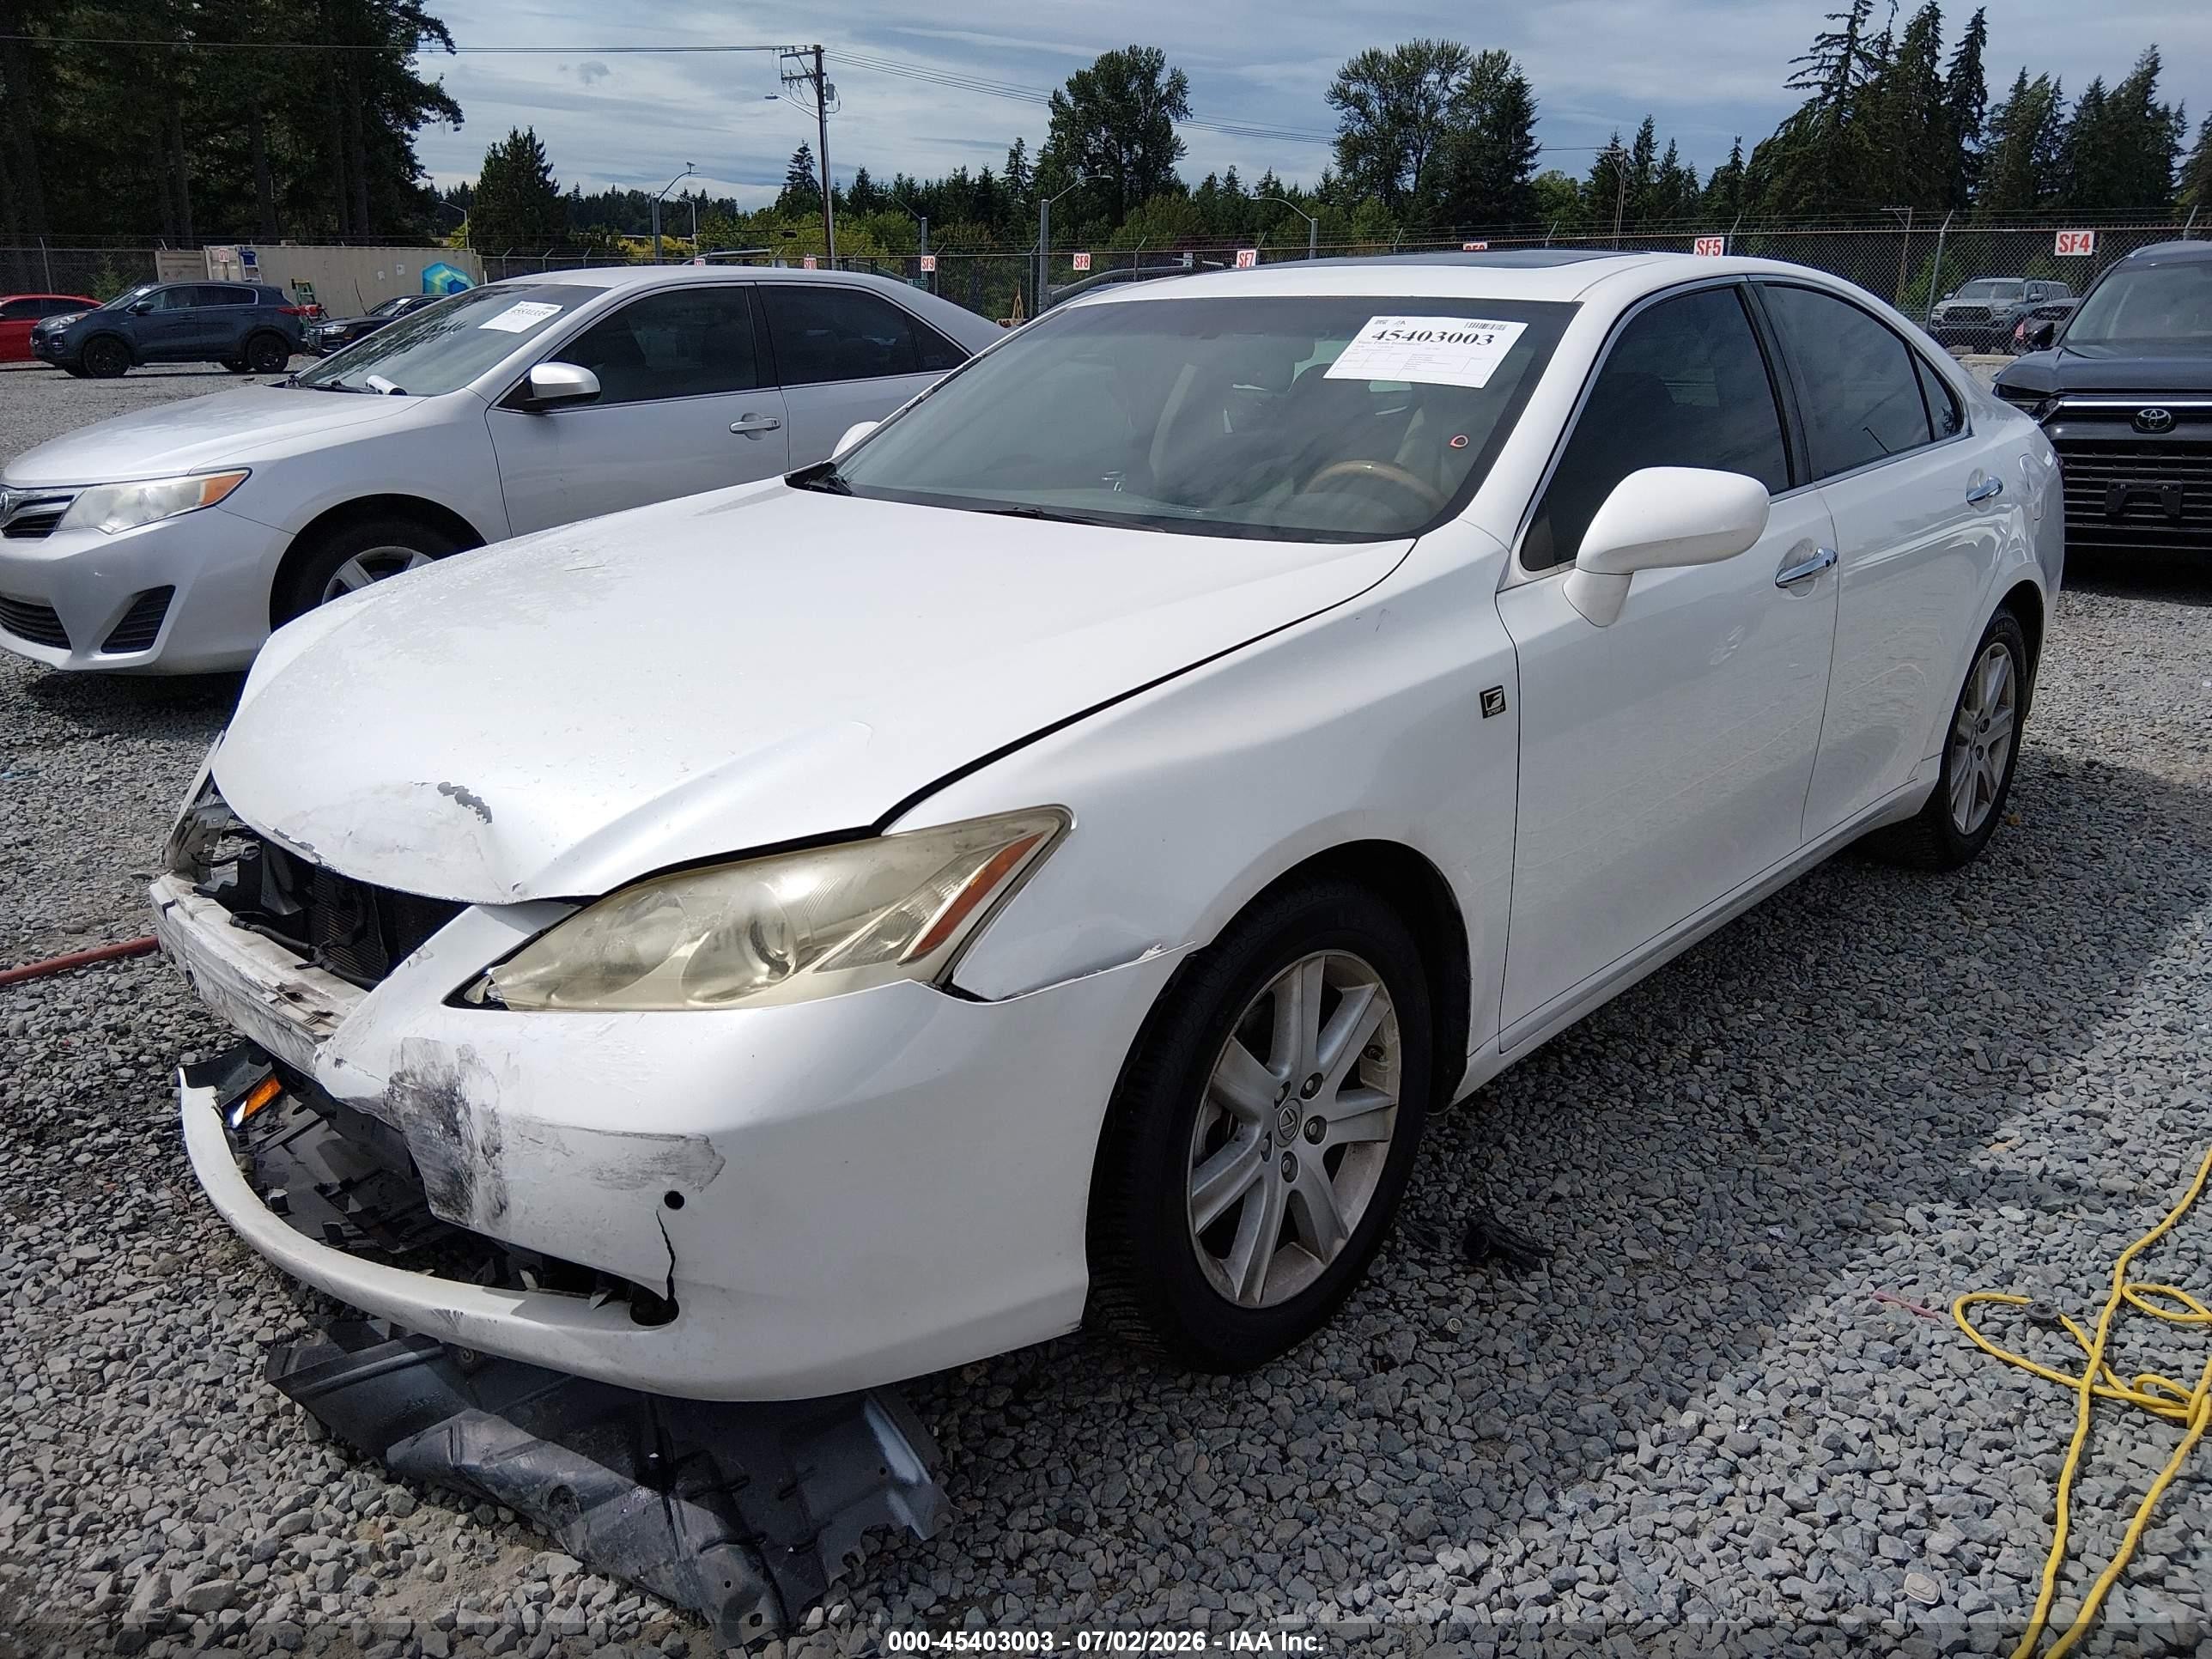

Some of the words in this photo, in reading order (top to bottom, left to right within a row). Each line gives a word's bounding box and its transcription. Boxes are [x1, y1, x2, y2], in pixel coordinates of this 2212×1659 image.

[1696, 240, 1722, 256] SF5
[2058, 234, 2090, 252] SF4
[922, 258, 934, 269] SF9
[1075, 255, 1089, 268] SF8
[1238, 252, 1255, 267] SF7
[1371, 330, 1495, 345] 45403003
